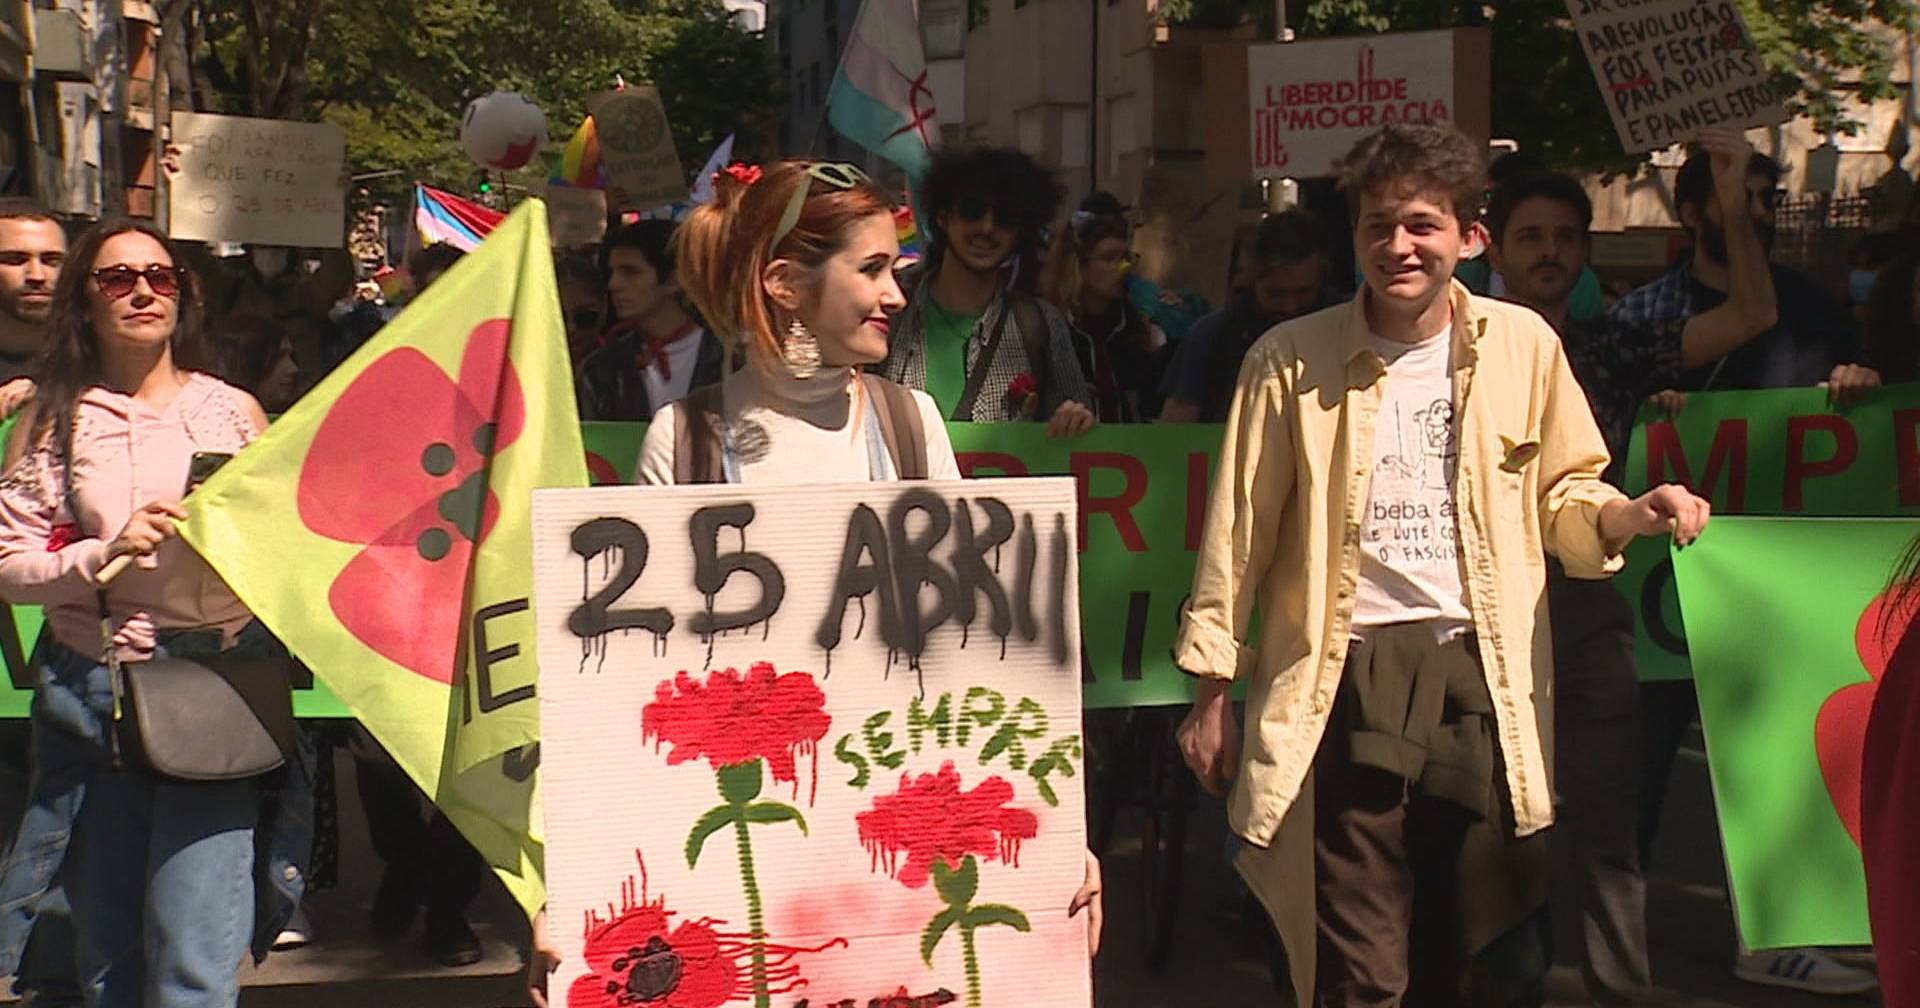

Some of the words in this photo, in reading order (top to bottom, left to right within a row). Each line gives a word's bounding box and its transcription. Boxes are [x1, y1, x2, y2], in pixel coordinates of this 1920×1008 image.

[1602, 50, 1652, 85] FOI
[1647, 80, 1778, 140] PANELEIRO
[204, 162, 248, 181] QUE
[264, 168, 297, 185] FEZ
[1373, 501, 1431, 520] beba
[1394, 525, 1429, 541] LUTE
[1379, 547, 1389, 562] O
[567, 502, 786, 660] 25
[834, 686, 1081, 807] SEMPRE
